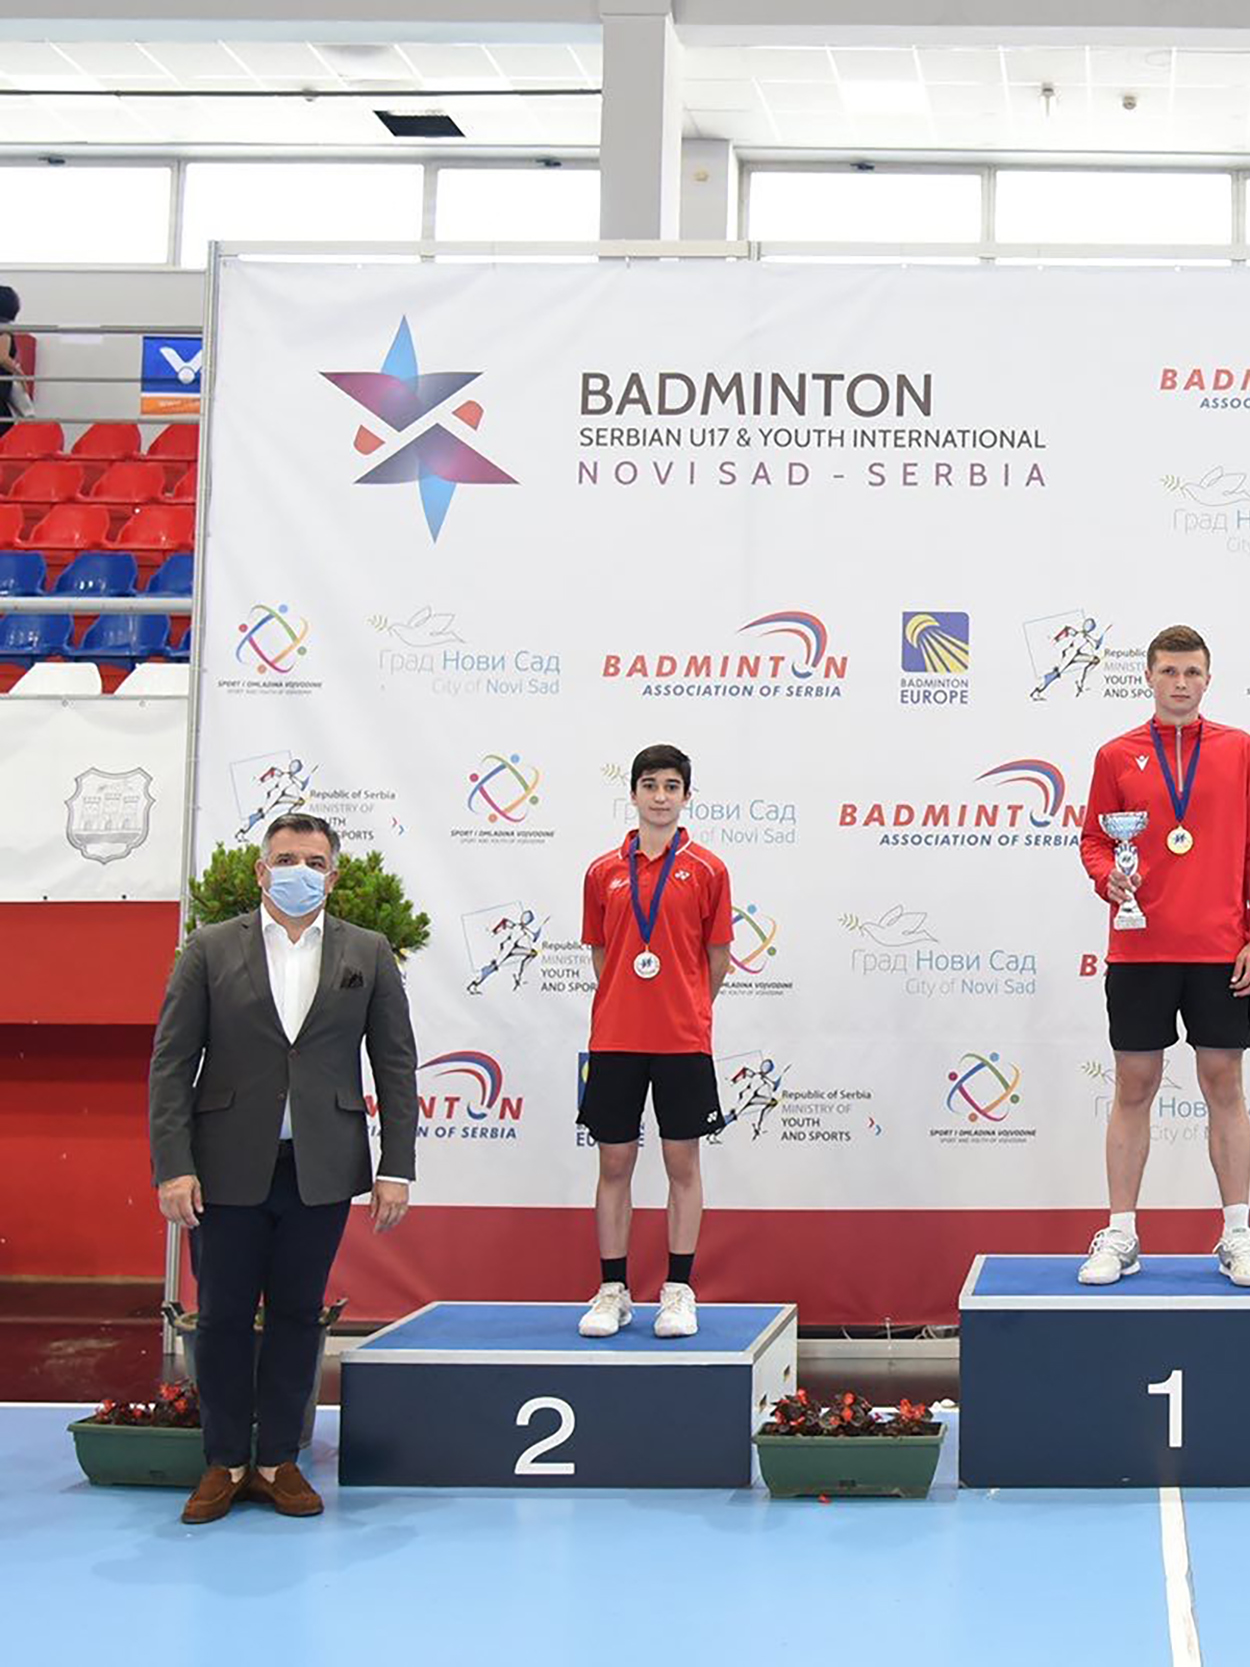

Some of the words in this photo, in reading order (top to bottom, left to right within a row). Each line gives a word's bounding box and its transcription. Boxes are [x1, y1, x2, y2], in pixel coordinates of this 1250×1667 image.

[580, 372, 932, 417] BADMINTON
[580, 428, 681, 447] SERBIAN
[689, 428, 728, 447] U17
[738, 429, 751, 447] &
[758, 429, 844, 448] YOUTH
[854, 429, 1046, 449] INTERNATIONAL
[578, 461, 695, 485] NOVI
[719, 462, 809, 486] SAD
[869, 463, 1046, 487] SERBIA
[443, 651, 505, 671] Нови
[515, 652, 560, 674] Сад
[901, 679, 969, 688] BADMINTON
[1104, 675, 1142, 685] YOUTH
[486, 680, 522, 694] Novi
[529, 680, 560, 694] Sad
[642, 684, 753, 696] ASSOCIATION
[759, 685, 780, 697] OF
[786, 685, 841, 697] SERBIA
[1104, 688, 1128, 698] AND
[901, 690, 969, 704] EUROPE
[310, 790, 350, 801] Republic
[353, 790, 362, 799] of
[364, 790, 395, 800] Serbia
[310, 804, 357, 813] MINISTRY
[750, 801, 796, 824] Сад
[721, 829, 758, 843] Novi
[764, 829, 795, 843] Sad
[880, 834, 992, 846] ASSOCIATION
[998, 834, 1020, 846] OF
[1025, 834, 1079, 846] SERBIA
[542, 940, 584, 952] Republic
[917, 951, 979, 971] Нови
[990, 951, 1036, 974] Сад
[542, 968, 579, 977] YOUTH
[542, 982, 565, 992] AND
[961, 979, 998, 995] Novi
[1004, 979, 1035, 995] Sad
[781, 1090, 827, 1101] Republic
[830, 1090, 838, 1099] of
[840, 1090, 871, 1099] Serbia
[781, 1104, 838, 1114] MINISTRY
[1159, 1097, 1206, 1117] Нов
[781, 1118, 819, 1127] YOUTH
[436, 1126, 456, 1137] OF
[462, 1127, 516, 1139] SERBIA
[781, 1131, 806, 1141] AND
[809, 1131, 850, 1141] SPORTS
[1148, 1369, 1183, 1447] 1
[514, 1396, 576, 1475] 2
